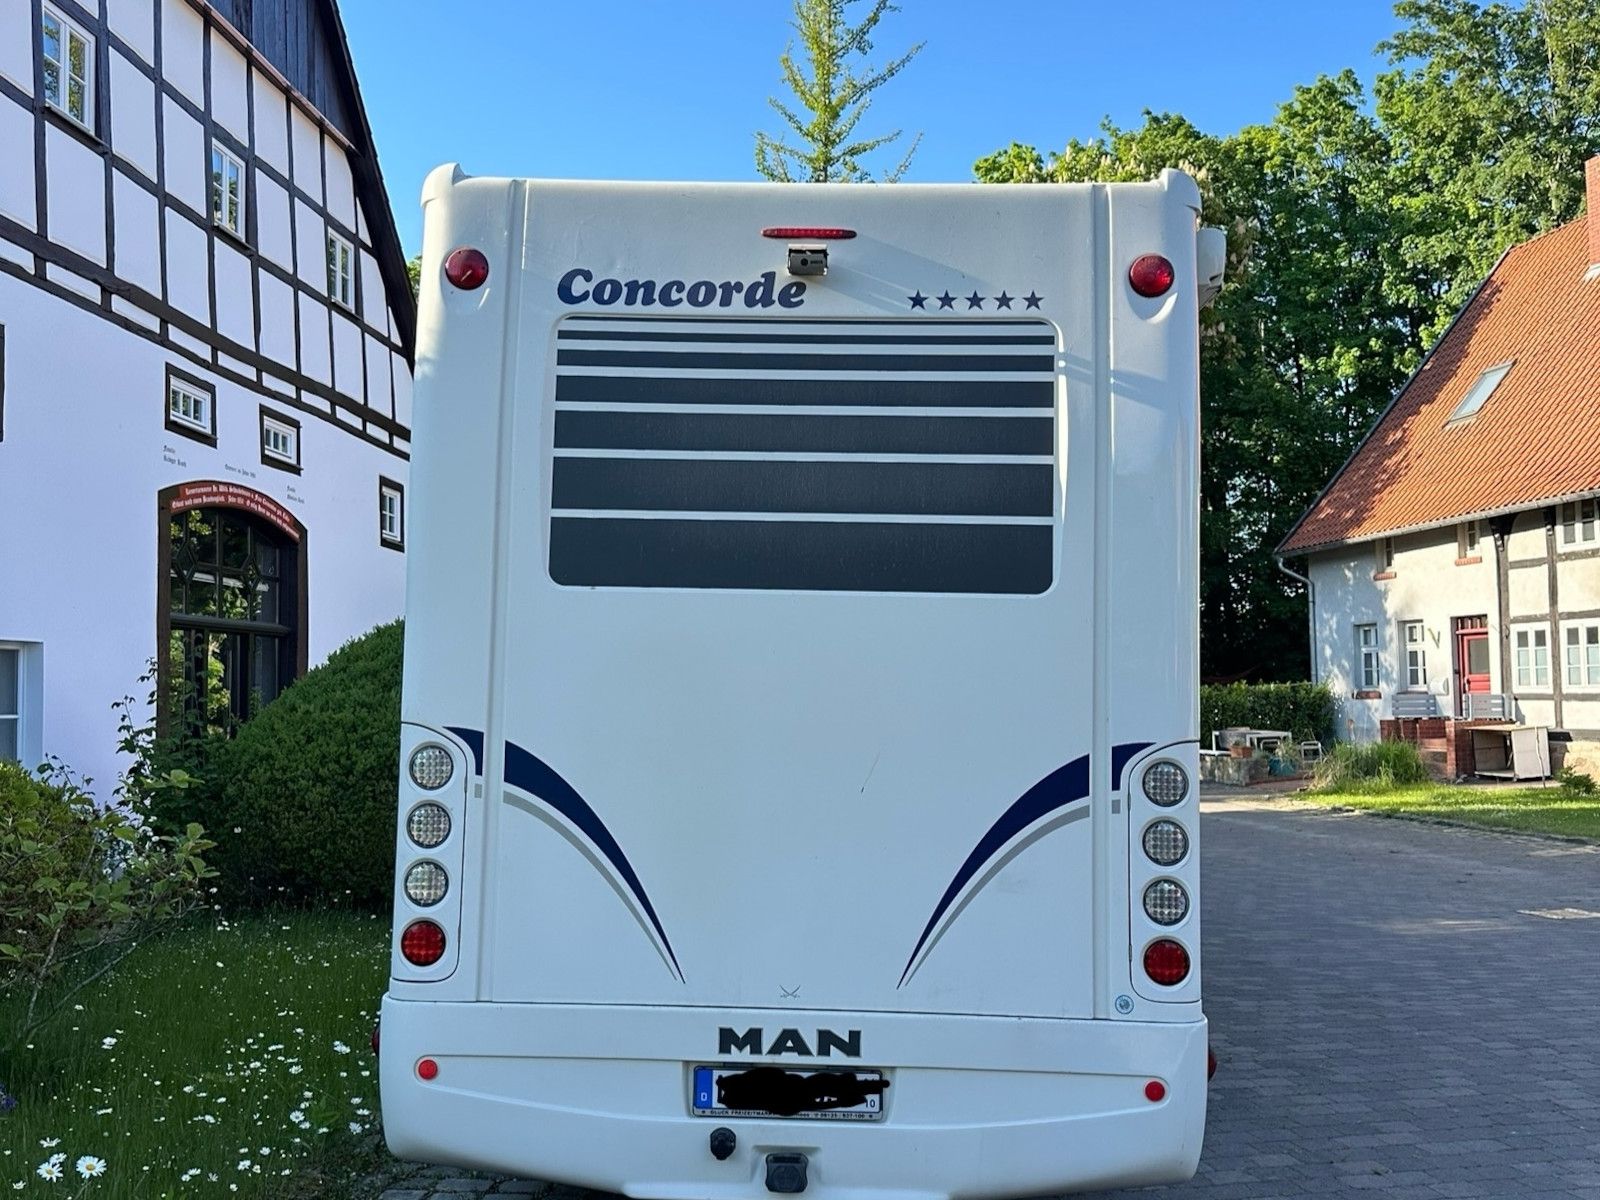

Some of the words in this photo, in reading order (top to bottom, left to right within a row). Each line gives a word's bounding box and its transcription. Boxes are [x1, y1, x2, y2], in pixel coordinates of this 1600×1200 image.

[557, 268, 807, 308] Concorde
[719, 1027, 861, 1057] MAN
[701, 1092, 708, 1101] D
